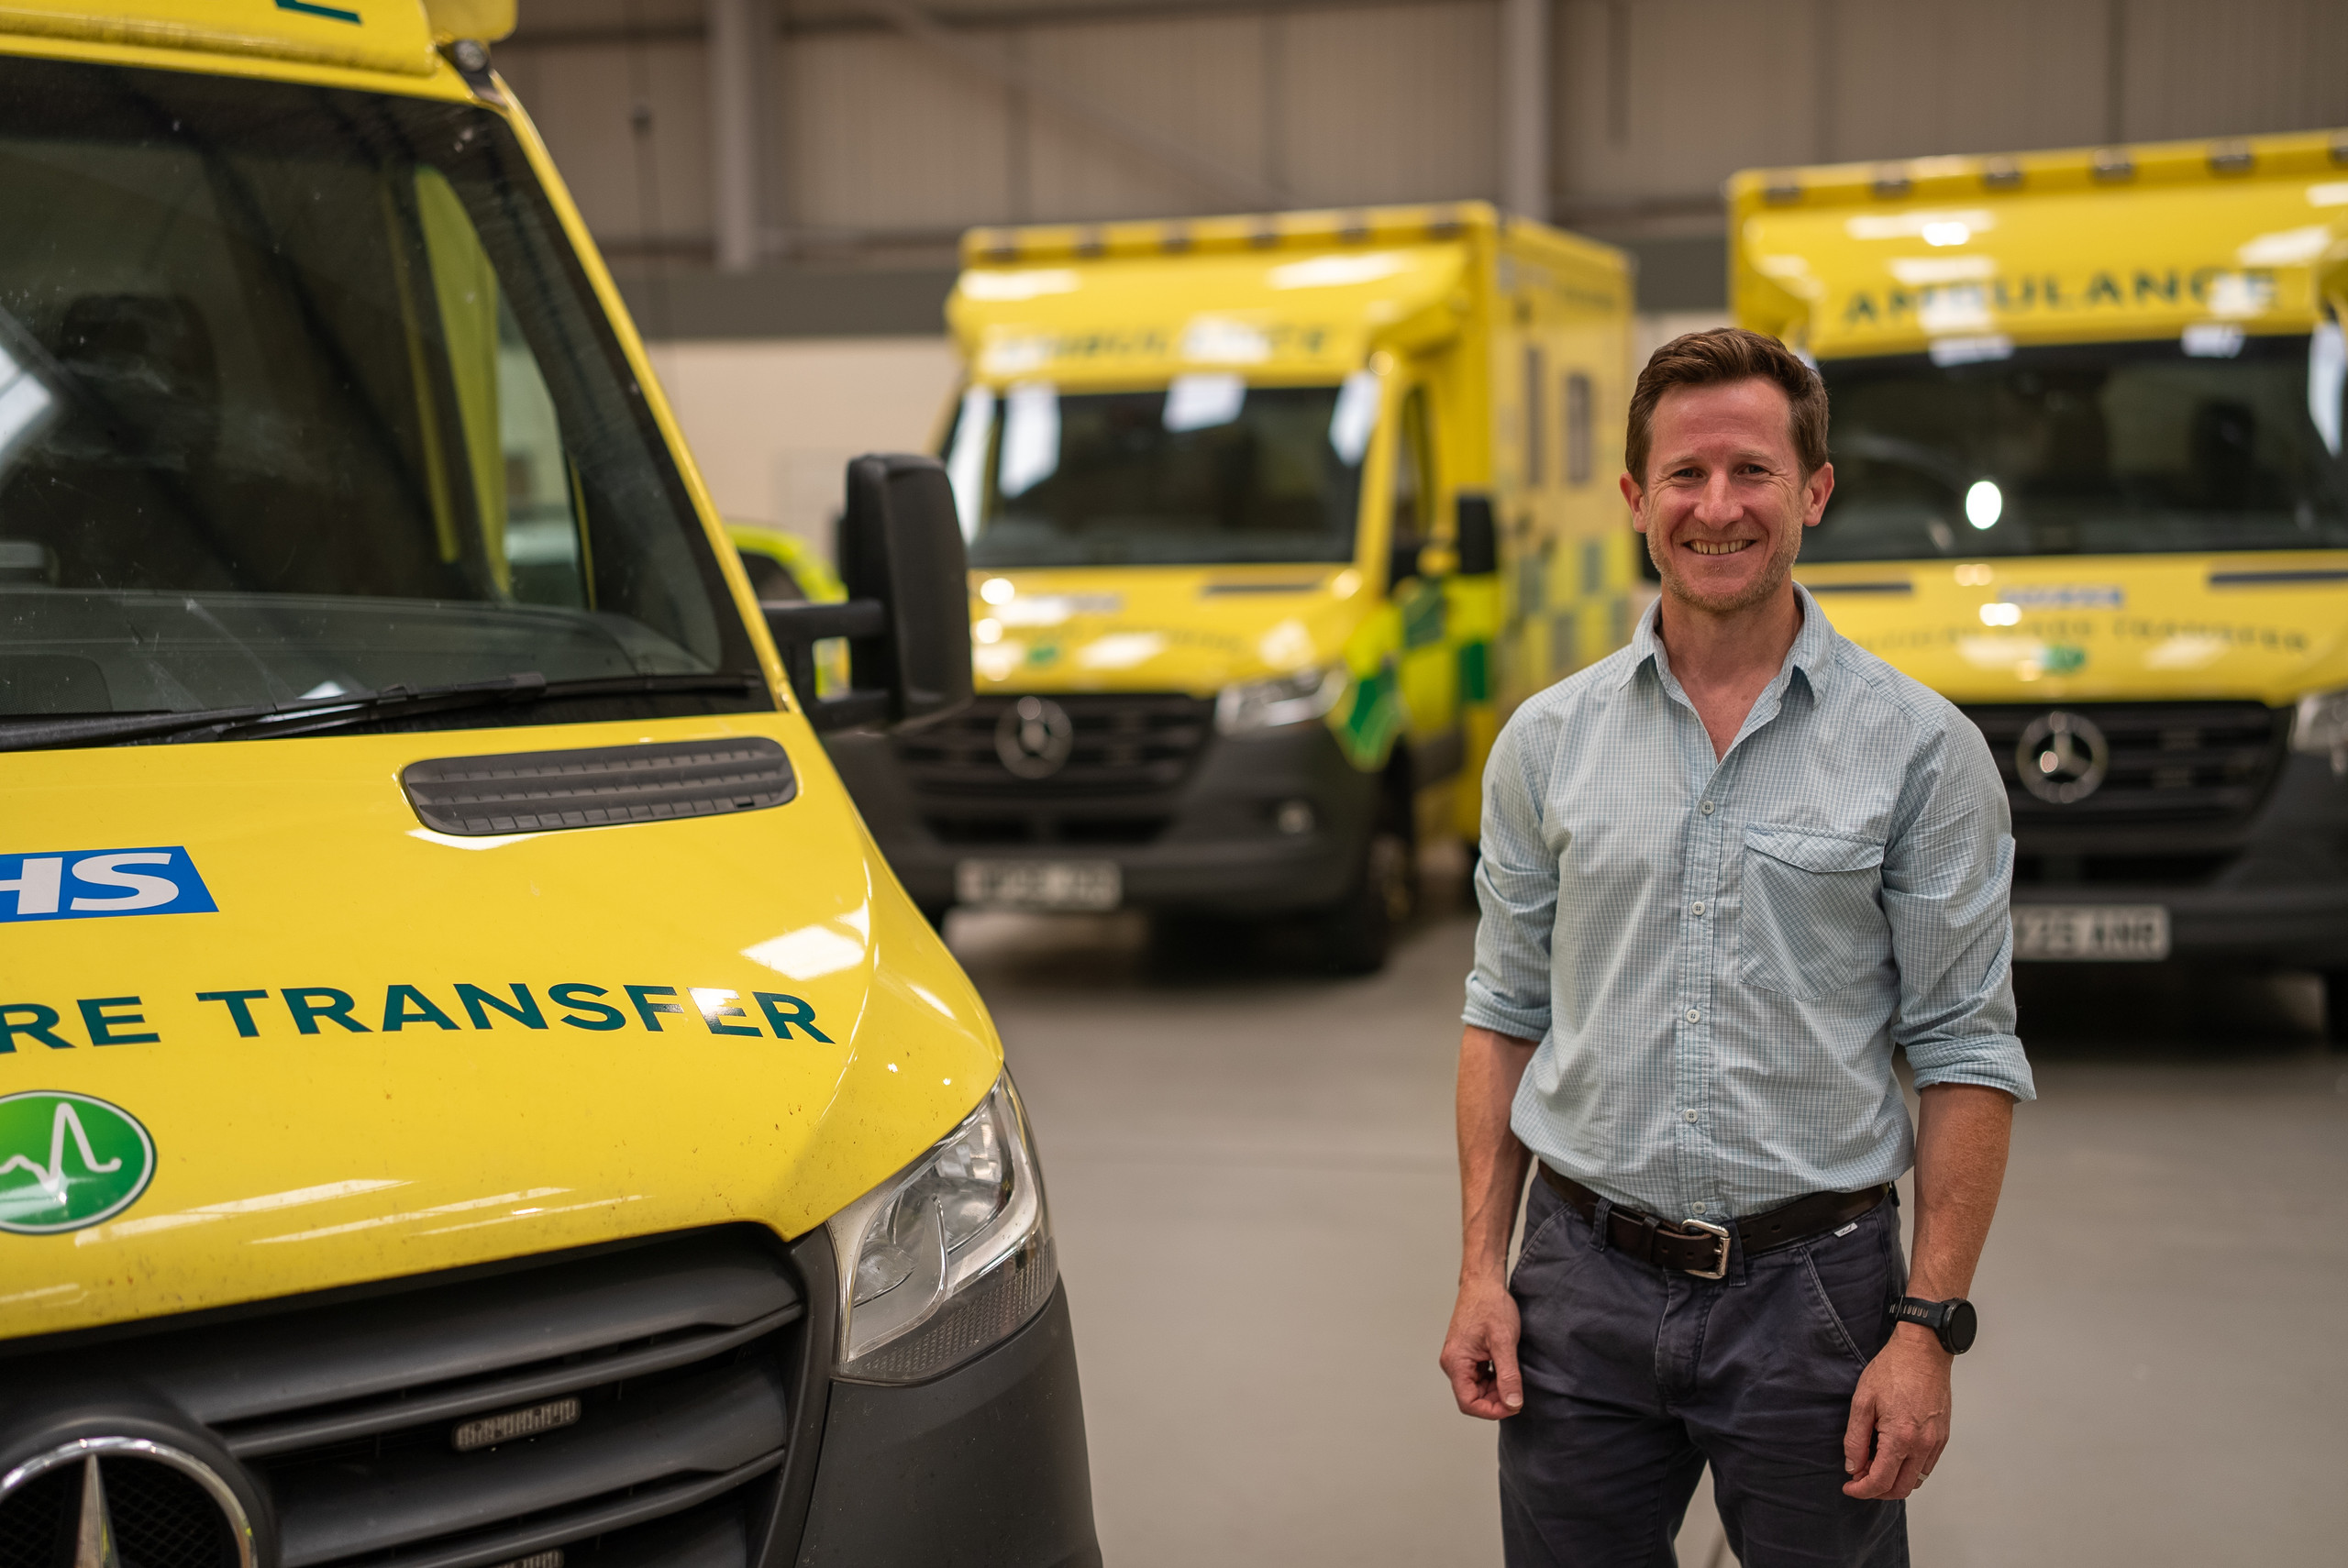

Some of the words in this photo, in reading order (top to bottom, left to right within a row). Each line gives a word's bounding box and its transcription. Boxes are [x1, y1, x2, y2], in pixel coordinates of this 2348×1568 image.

[1844, 266, 2278, 324] AMBULANCE
[0, 852, 180, 915] HS
[0, 996, 161, 1054] RE
[195, 983, 836, 1044] TRANSFER
